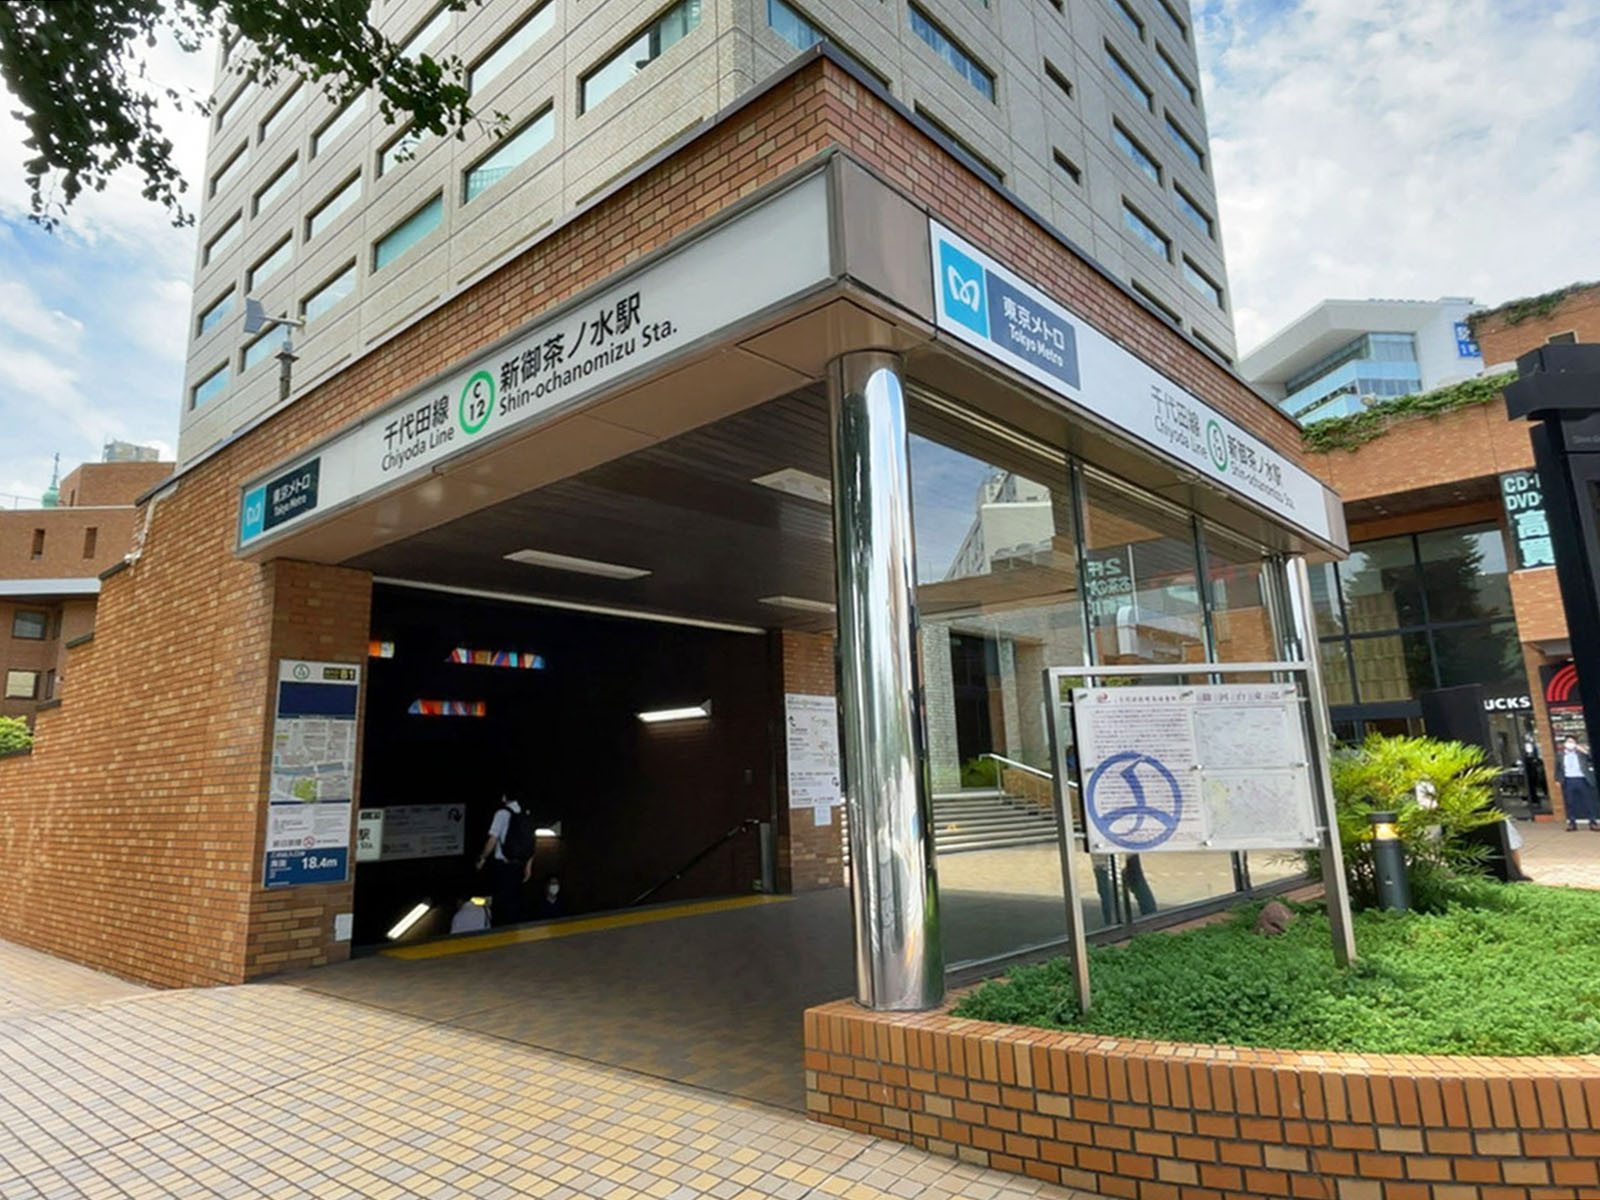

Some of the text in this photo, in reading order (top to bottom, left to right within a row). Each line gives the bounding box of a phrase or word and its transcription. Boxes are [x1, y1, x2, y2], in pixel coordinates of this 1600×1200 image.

[500, 291, 641, 393] 新御茶ノ水駅
[1003, 295, 1065, 351] 東京メトロ
[1009, 323, 1063, 367] Tokyo Metro
[473, 381, 481, 399] C
[499, 320, 678, 416] Shin-ochanomizu Sta.
[384, 394, 449, 451] 千代田線
[469, 399, 486, 421] 12
[382, 426, 455, 471] Chiyoda Line
[1483, 696, 1531, 711] UCKS
[301, 855, 339, 870] 18.4m
